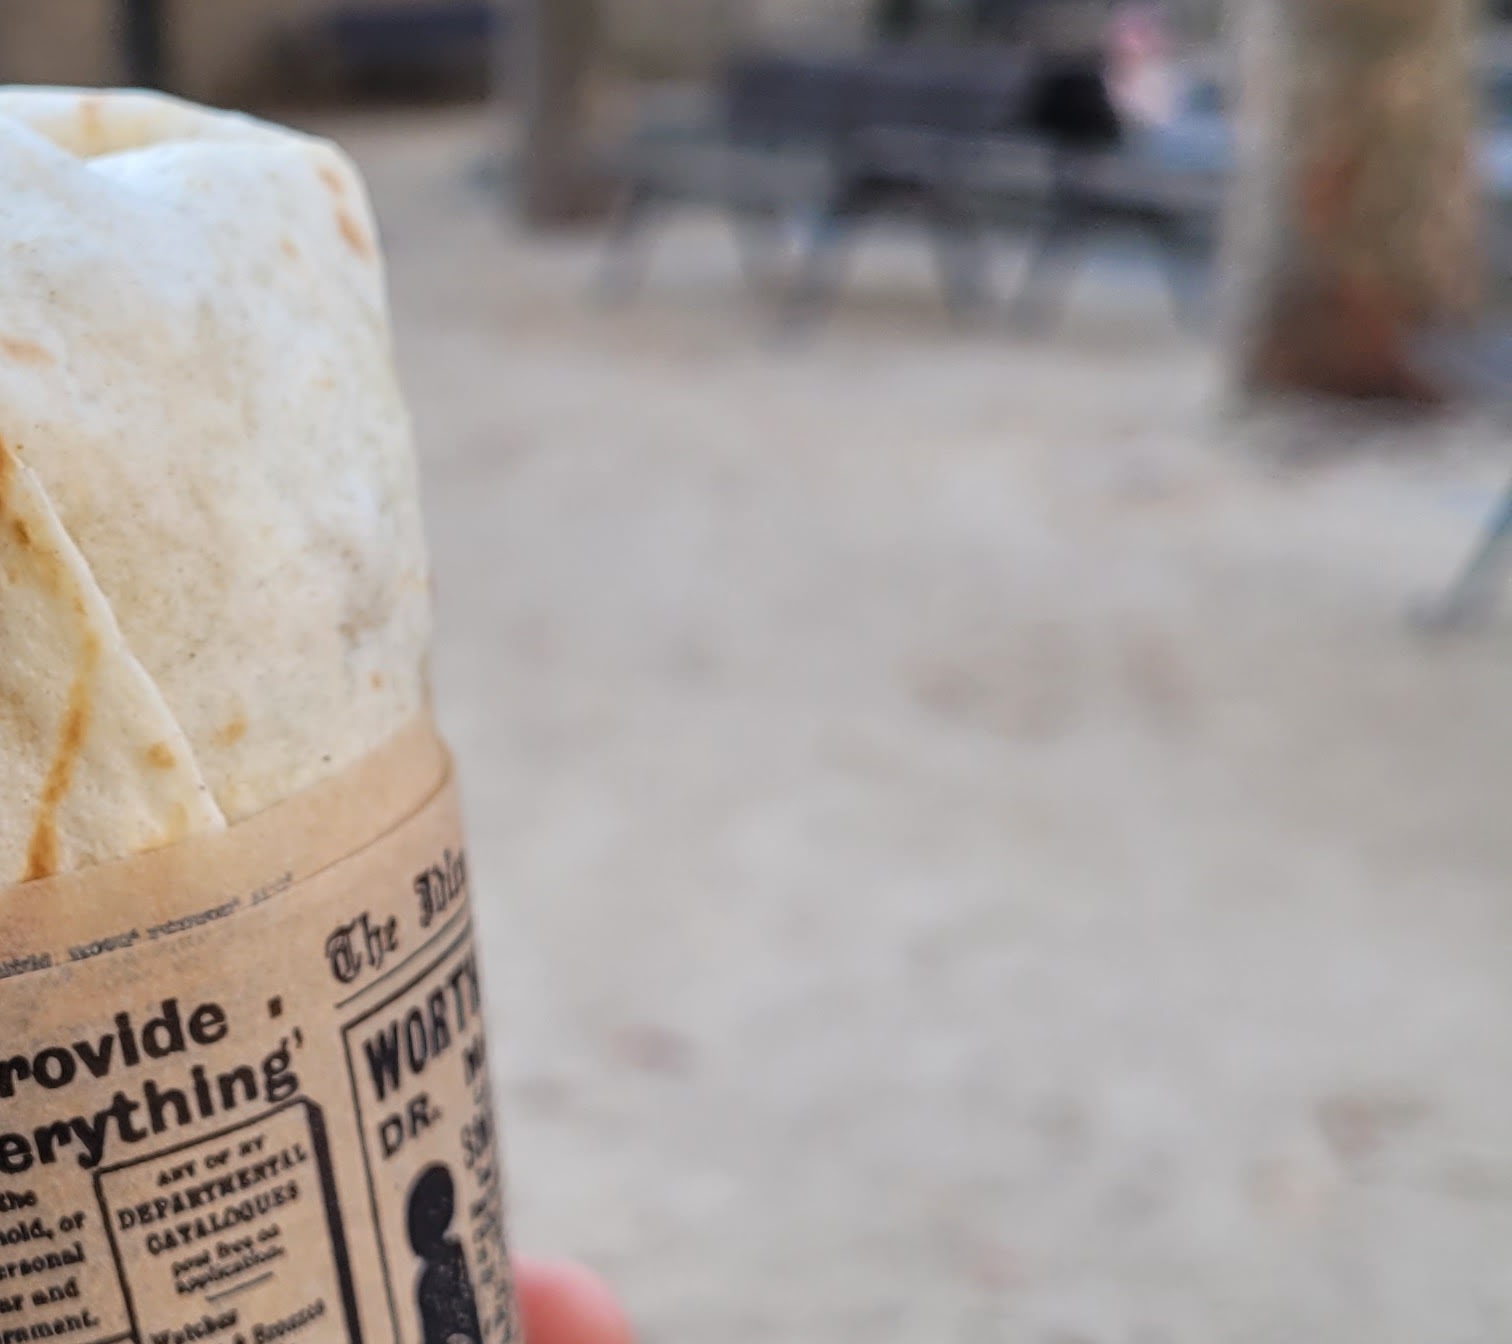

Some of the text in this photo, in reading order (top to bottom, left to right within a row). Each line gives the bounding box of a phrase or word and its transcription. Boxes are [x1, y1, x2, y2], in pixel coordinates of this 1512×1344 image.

[116, 1143, 307, 1231] DEPARTMENTAL
[59, 1211, 87, 1233] or
[146, 1180, 299, 1255] CATALOGUES
[33, 1277, 79, 1306] and
